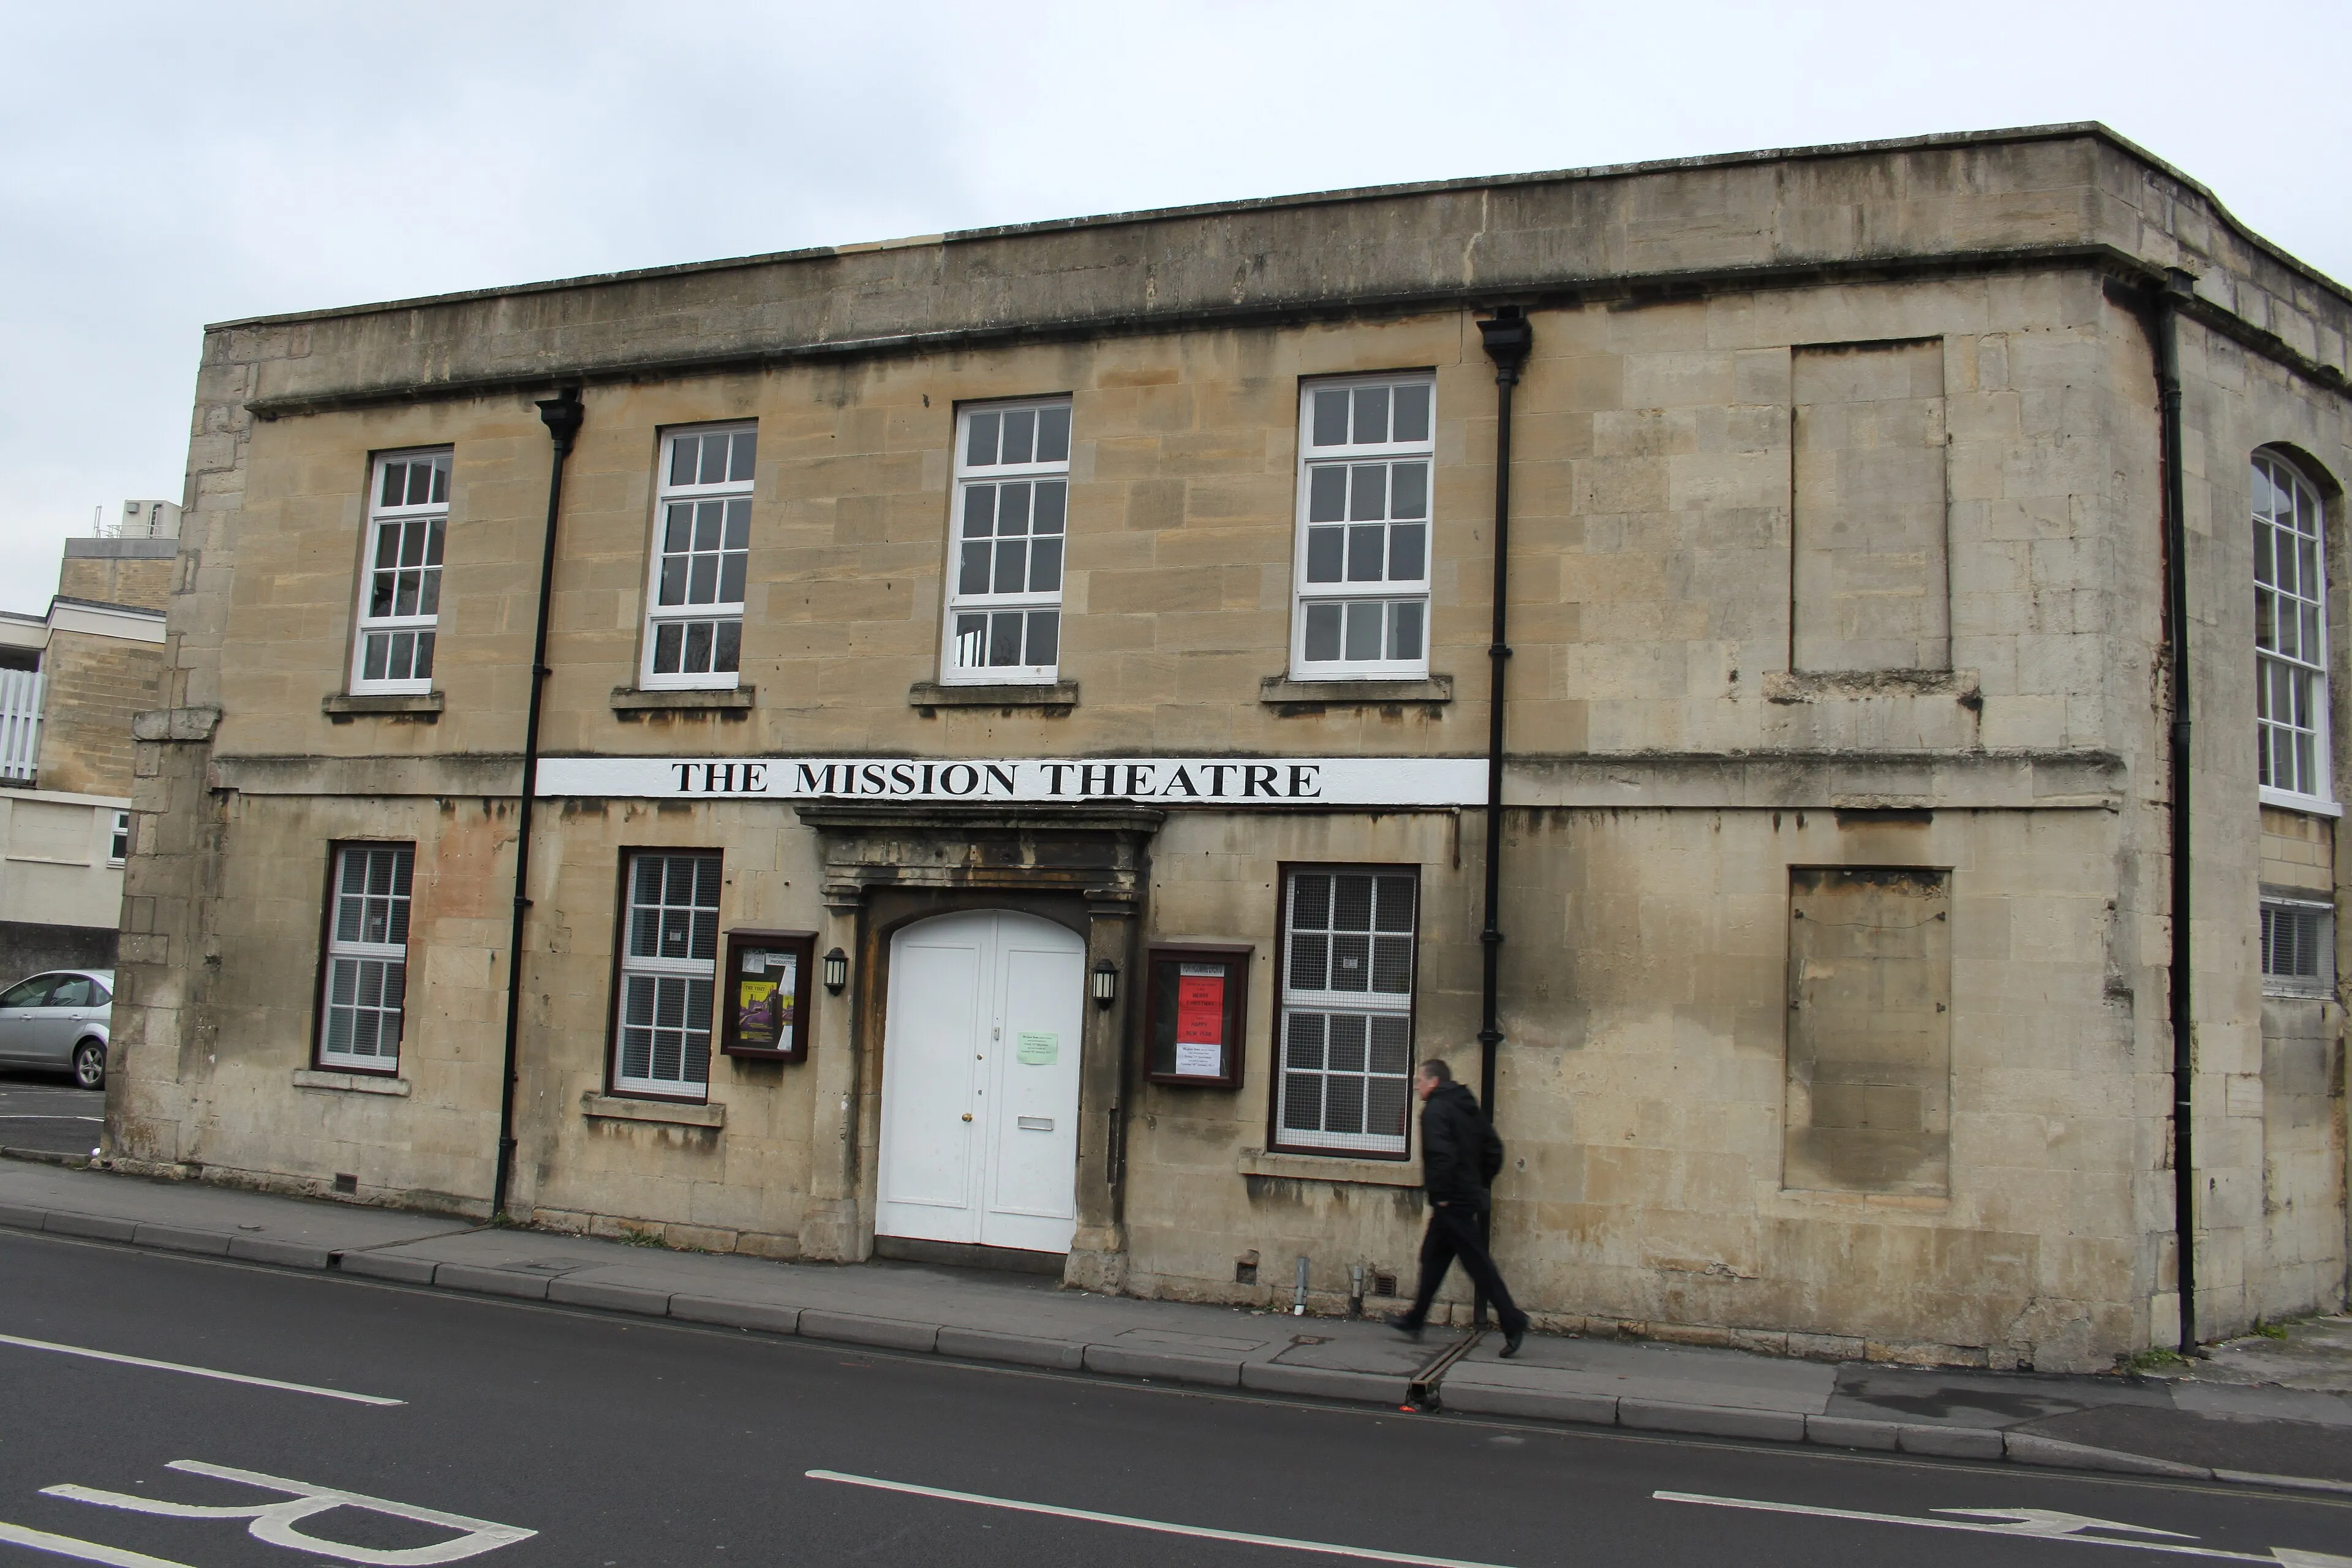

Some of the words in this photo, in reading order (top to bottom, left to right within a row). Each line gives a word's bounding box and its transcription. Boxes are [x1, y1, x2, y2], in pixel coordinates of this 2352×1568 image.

[671, 763, 767, 792] THE
[793, 763, 1020, 796] MISSION
[1040, 764, 1322, 797] THEATRE
